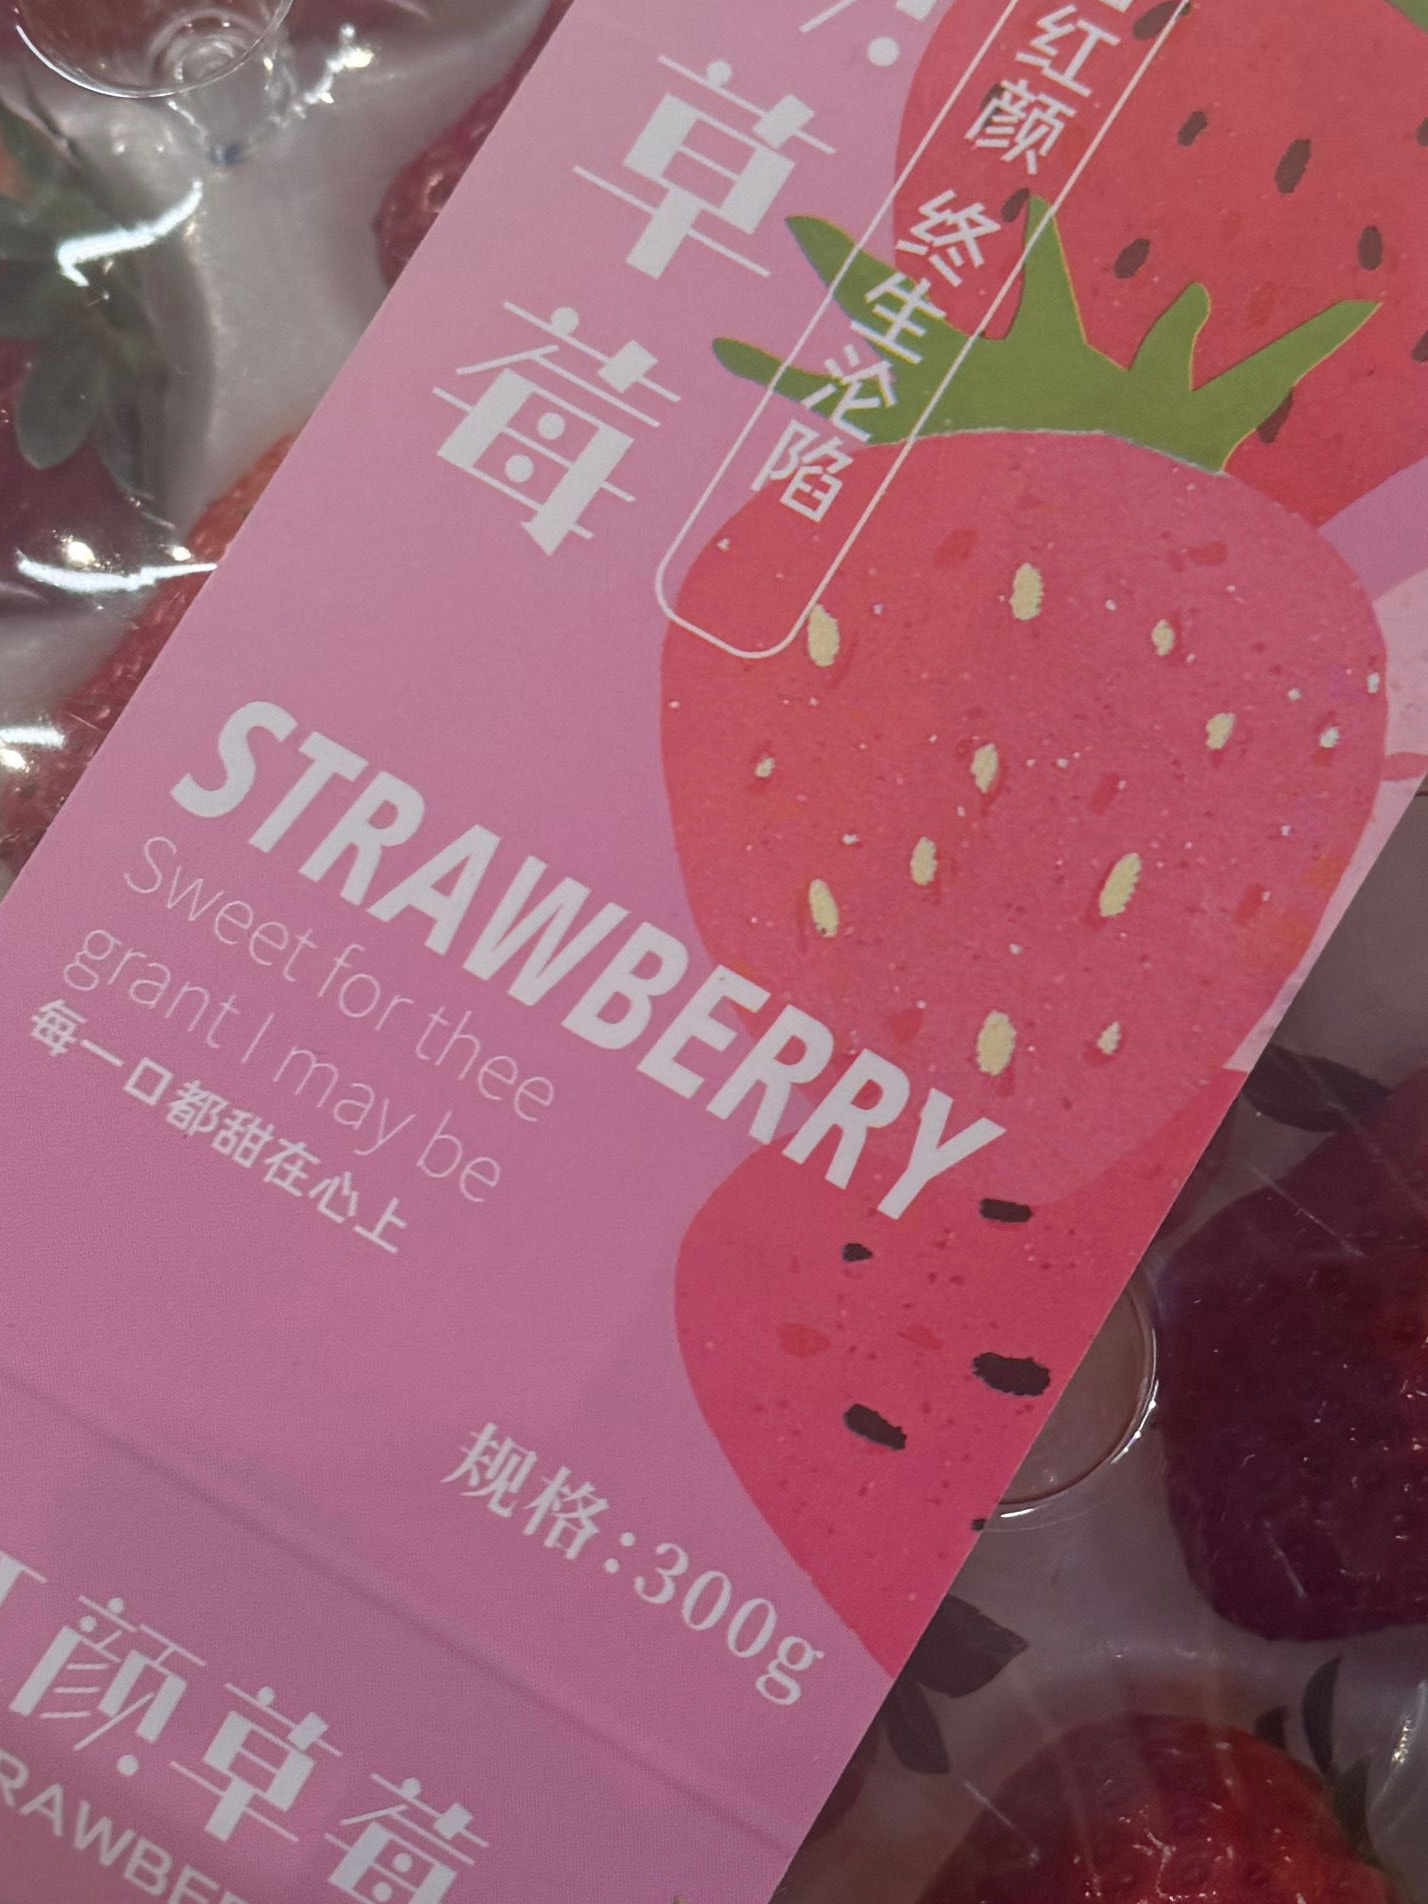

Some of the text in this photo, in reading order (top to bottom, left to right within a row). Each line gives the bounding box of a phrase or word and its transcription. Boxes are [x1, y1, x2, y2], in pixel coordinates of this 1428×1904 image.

[752, 188, 1000, 524] 终生沦陷
[63, 928, 241, 1050] grant
[272, 1046, 415, 1156] may
[416, 1111, 502, 1203] be
[123, 835, 556, 1123] Sweet for thee
[170, 699, 1006, 1221] STRAWBERRY
[28, 999, 413, 1254] 每一口都甜在心上
